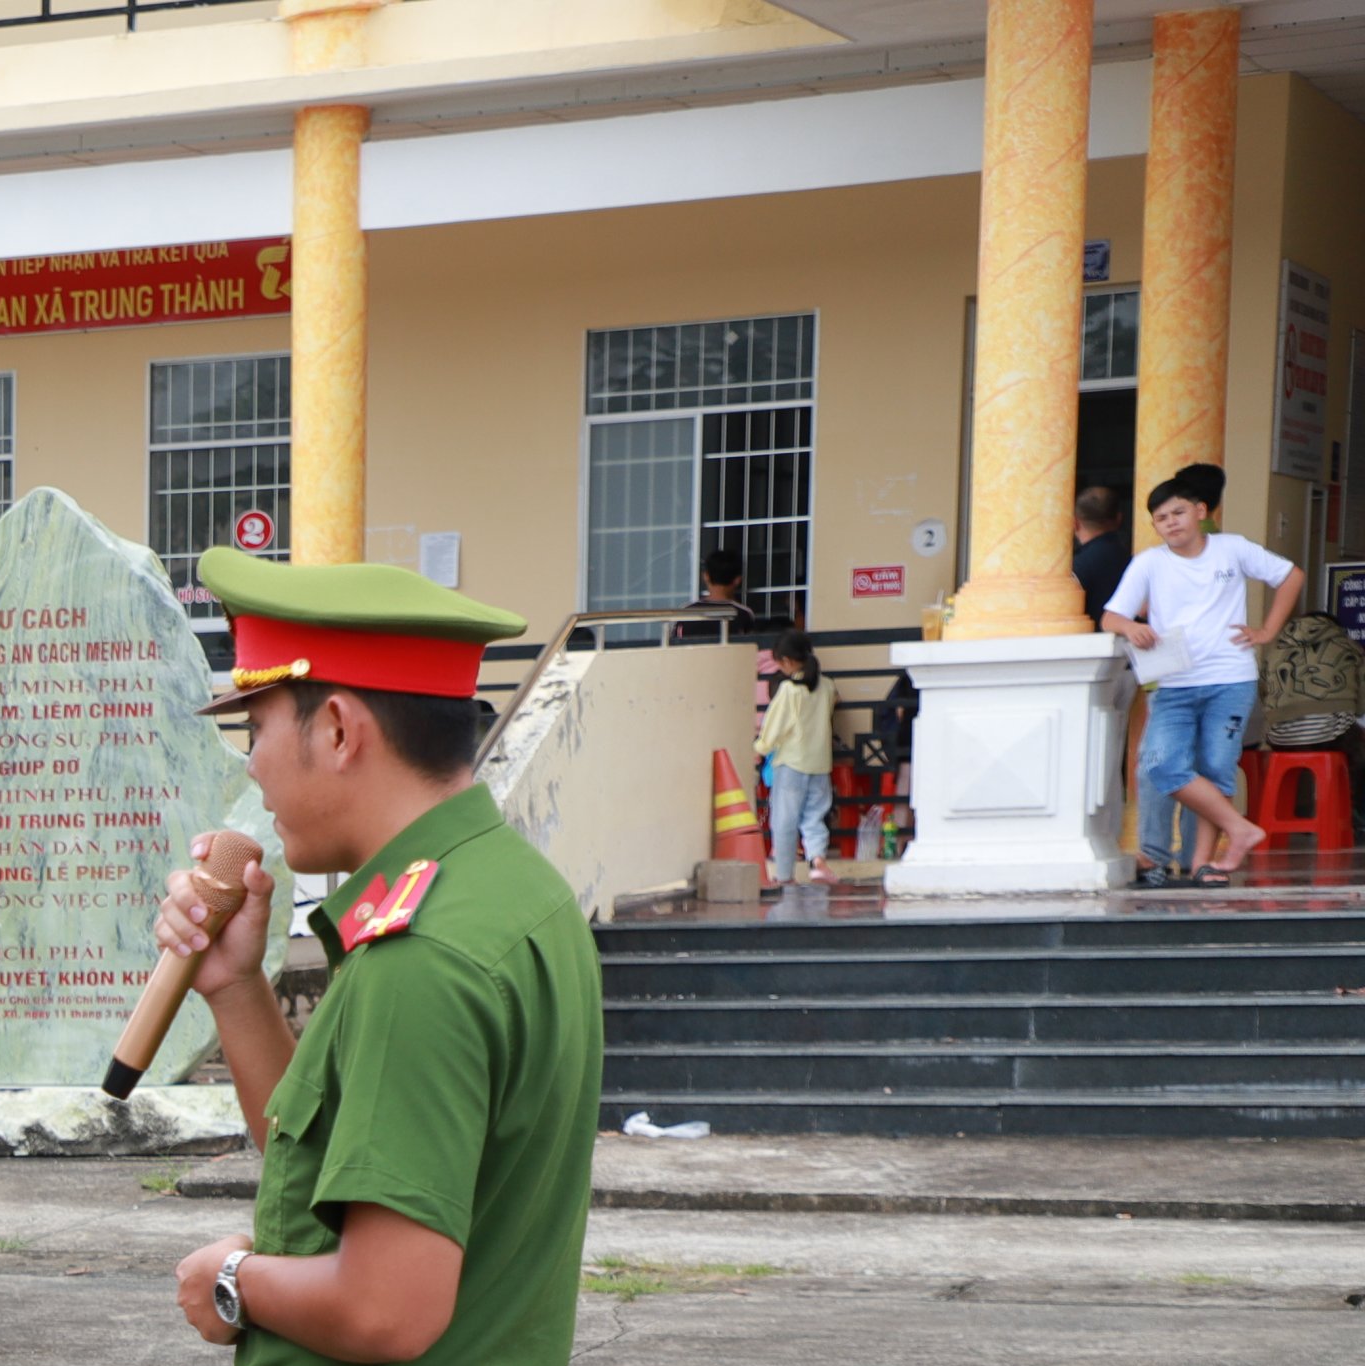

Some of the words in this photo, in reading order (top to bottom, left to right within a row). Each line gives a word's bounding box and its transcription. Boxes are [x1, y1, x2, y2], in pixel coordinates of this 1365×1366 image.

[34, 287, 66, 326] XÃ
[70, 285, 154, 323] TRUNG
[159, 275, 245, 316] THÀNH
[242, 517, 265, 545] 2
[925, 529, 935, 548] 2
[22, 605, 88, 629] CÁCH
[11, 643, 33, 664] AN
[18, 812, 85, 830] TRUNG
